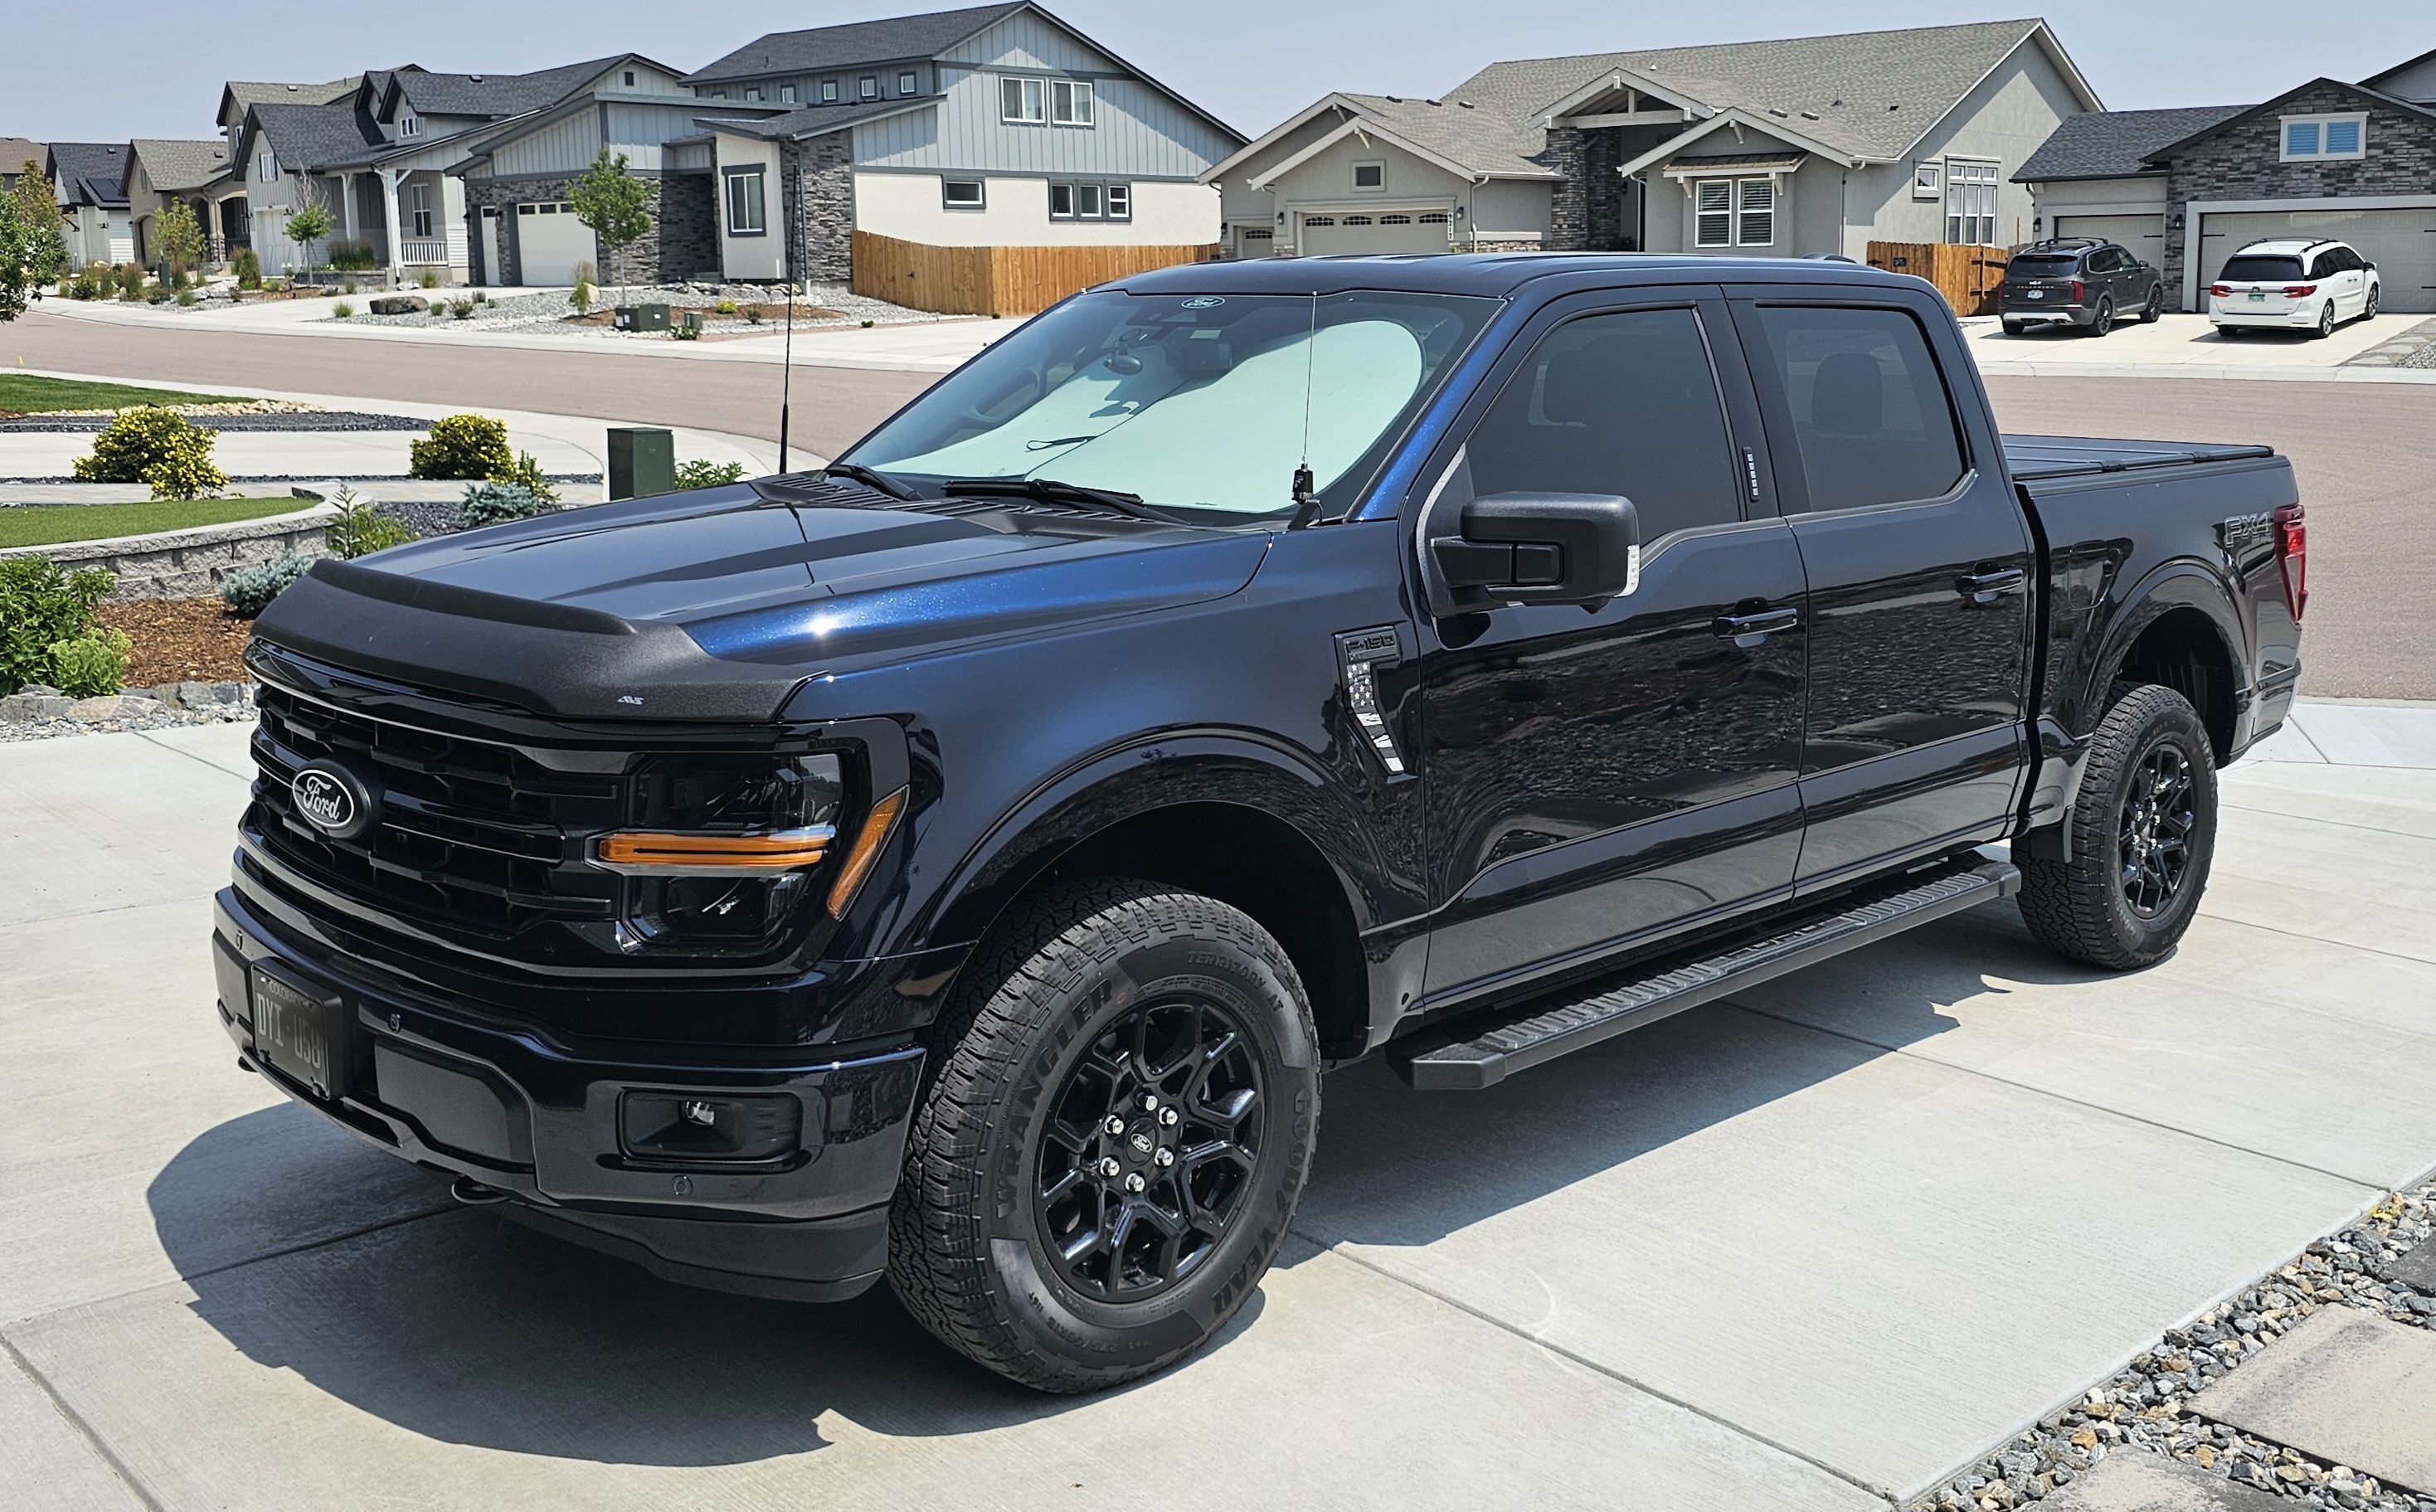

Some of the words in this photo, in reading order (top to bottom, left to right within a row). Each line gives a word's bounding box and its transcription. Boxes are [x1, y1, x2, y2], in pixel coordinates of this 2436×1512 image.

[2224, 512, 2272, 547] FX4
[1346, 634, 1395, 653] F-150
[303, 775, 342, 821] Ford
[1189, 950, 1266, 989] TERRITORY
[1267, 994, 1285, 1012] AT
[997, 977, 1112, 1219] WRANGLER
[1134, 1136, 1150, 1150] Ford
[1211, 1088, 1310, 1315] GOODYEAR
